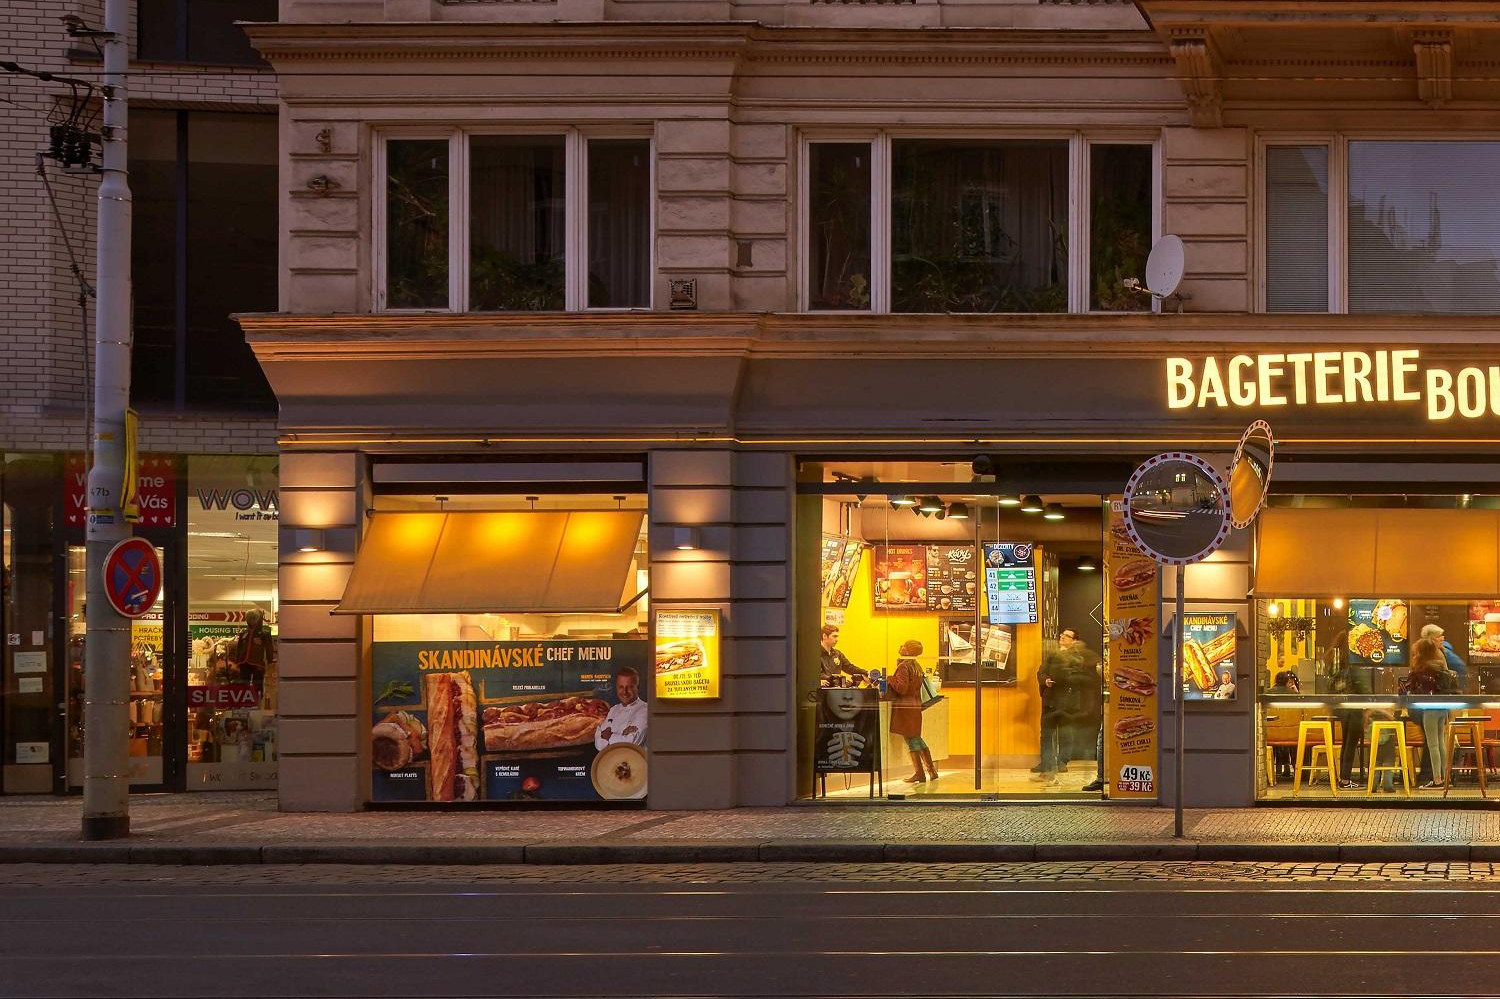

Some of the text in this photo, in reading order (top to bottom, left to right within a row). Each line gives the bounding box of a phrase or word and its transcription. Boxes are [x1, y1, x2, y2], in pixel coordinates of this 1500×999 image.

[1165, 349, 1421, 409] BAGETERIE
[1184, 615, 1228, 625] KANDINÁVSKÉ
[418, 644, 612, 670] SKANDINÁVSKÉ CHEF MENU
[1122, 767, 1151, 781] 49 Kč
[1129, 781, 1140, 792] 39
[1141, 781, 1153, 792] Kč
